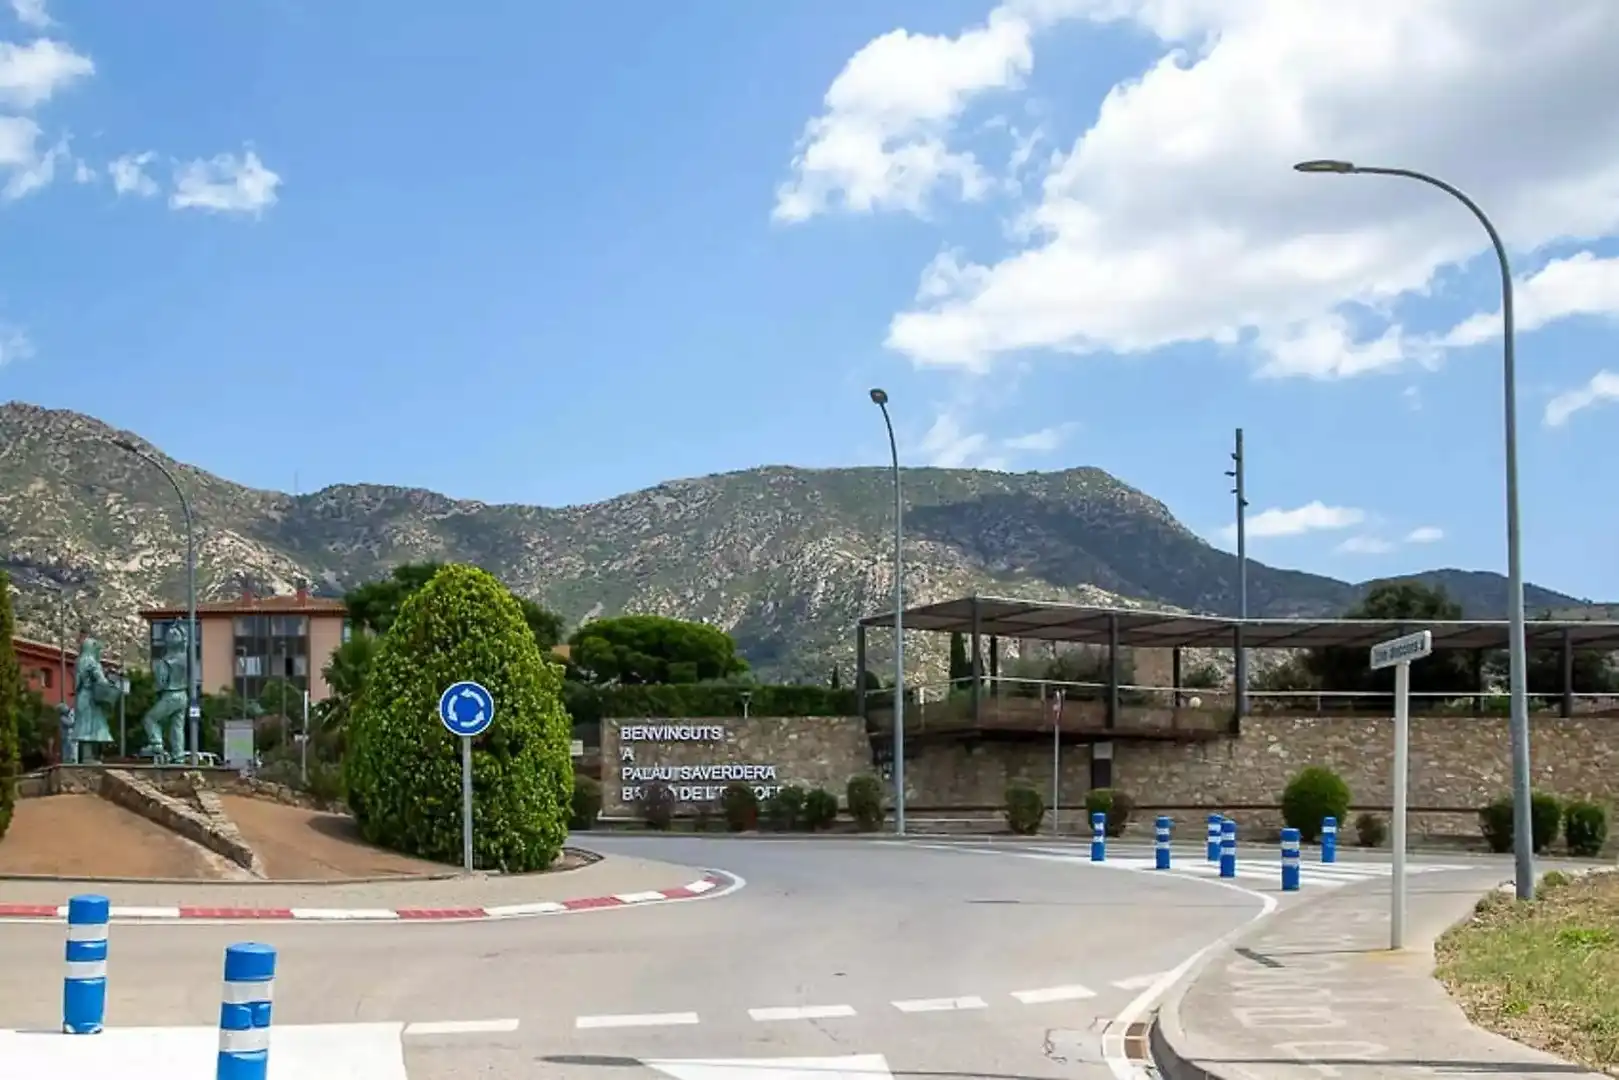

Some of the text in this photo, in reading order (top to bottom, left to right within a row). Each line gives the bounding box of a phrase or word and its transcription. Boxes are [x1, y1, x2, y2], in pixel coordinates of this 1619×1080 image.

[621, 726, 723, 740] BENVINGUTS
[622, 747, 634, 760] A
[680, 766, 776, 780] SAVERDERA
